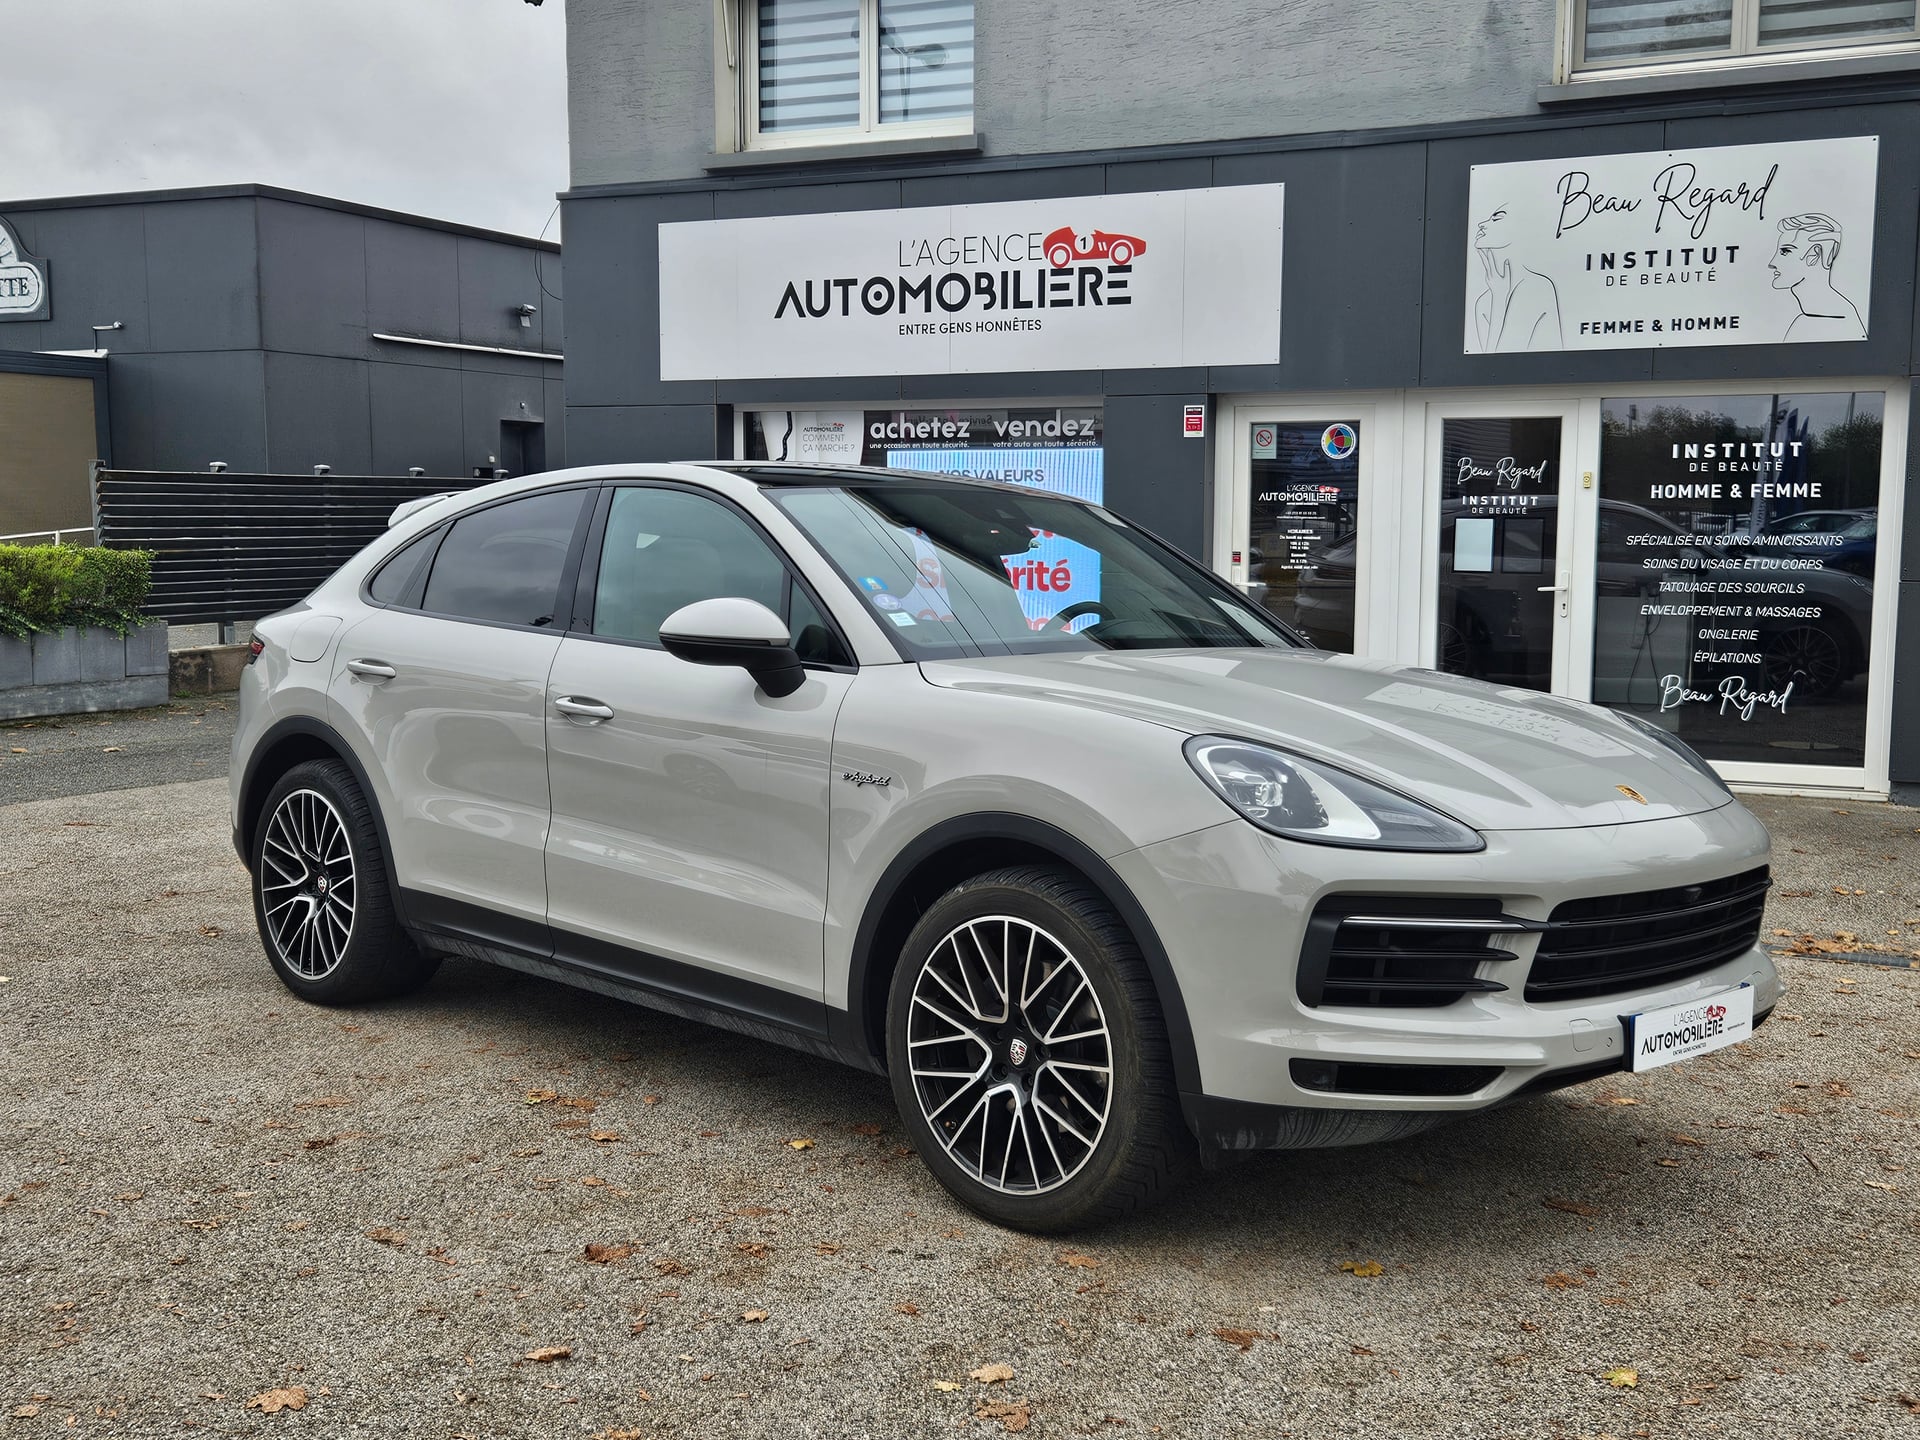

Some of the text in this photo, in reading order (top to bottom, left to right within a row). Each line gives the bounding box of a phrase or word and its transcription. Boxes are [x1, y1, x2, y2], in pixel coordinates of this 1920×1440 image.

[1556, 163, 1779, 239] Beau Regard
[899, 233, 1042, 268] L'AGENCE
[1586, 246, 1739, 271] INSTITUT
[1606, 267, 1717, 286] DE BEAUTÉ
[899, 317, 1041, 335] ENTRE GENS HONNÊTES
[1580, 316, 1739, 334] FEMME & HOMME
[870, 409, 1095, 439] achetez vendez
[803, 434, 845, 442] COMMENT
[992, 440, 1012, 448] votre
[816, 444, 848, 452] MARCHE
[883, 441, 911, 449] occasion
[922, 441, 940, 449] toute
[1673, 442, 1802, 459] INSTITUT
[1690, 459, 1783, 472] DE BEAUTÉ
[974, 469, 1045, 483] VALEURS
[1457, 457, 1547, 489] Beau Regard
[1286, 484, 1319, 492] L'AGENCE
[1651, 483, 1821, 498] HOMME & FEMME
[1463, 495, 1538, 506] INSTITUT
[1489, 506, 1528, 515] BEAUTÉ
[1626, 533, 1843, 545] SPÉCIALISÉ EN SOINS AMINCISSANTS
[1643, 559, 1823, 570] SOINS DU VISAGE ET DU CORPS
[1659, 582, 1805, 593] TATOUAGE DES SOURCILS
[1641, 605, 1821, 617] ENVELOPPEMENT & MASSAGES
[1699, 629, 1759, 640] ONGLERIE
[1694, 650, 1762, 663] ÉPILATIONS
[1661, 675, 1793, 721] Beau Regard
[1674, 1006, 1708, 1026] L'AGENCE
